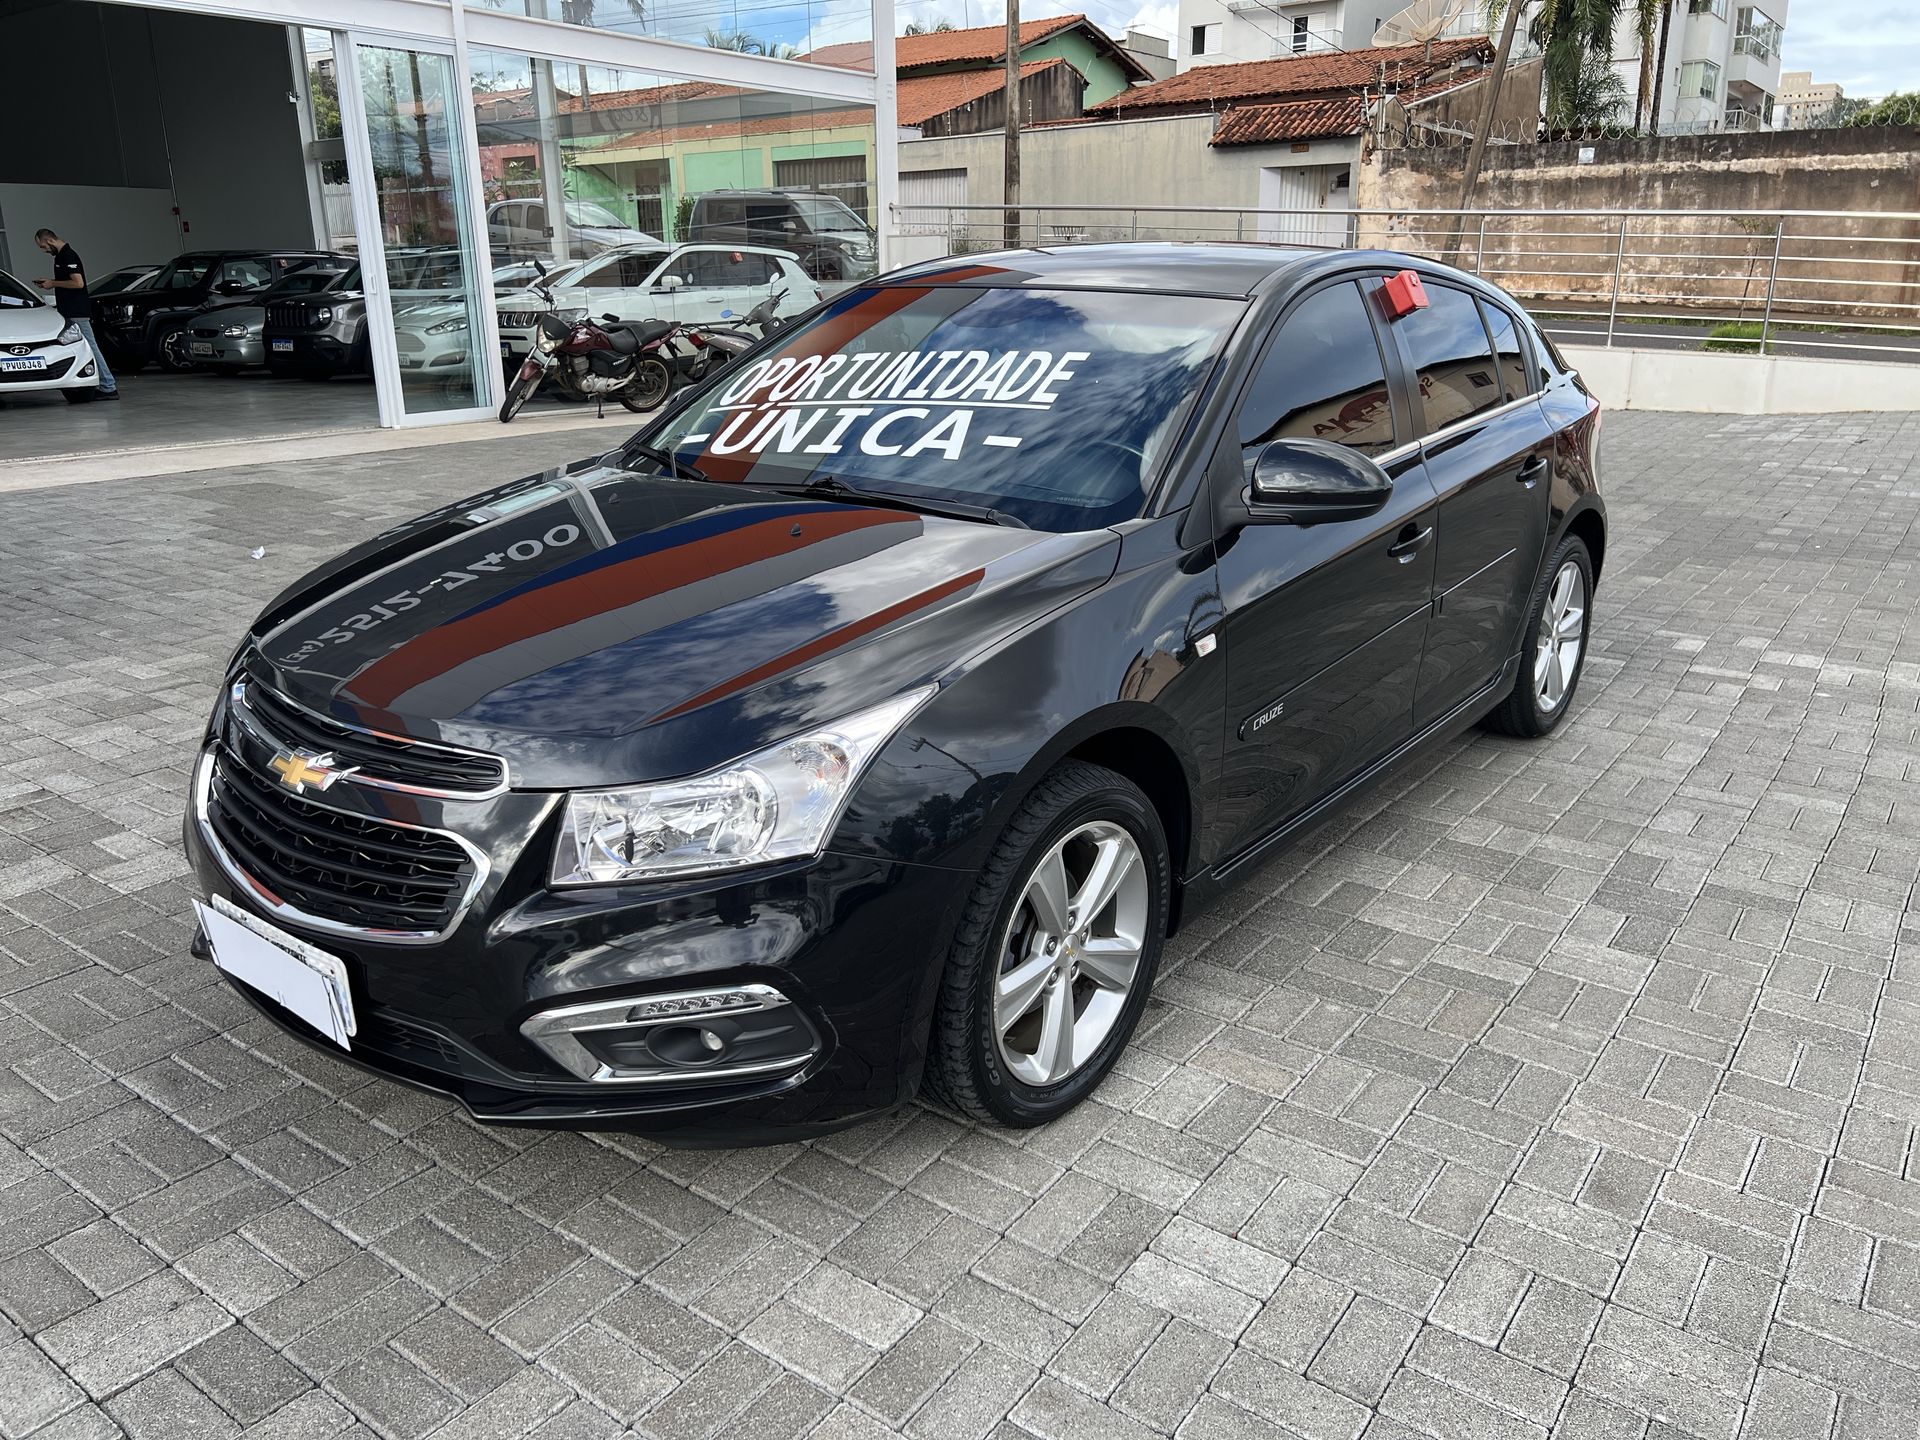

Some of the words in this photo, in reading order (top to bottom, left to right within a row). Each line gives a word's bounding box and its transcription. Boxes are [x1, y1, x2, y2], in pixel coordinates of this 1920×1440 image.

[6, 361, 42, 370] PWU8J48
[719, 350, 1091, 403] OPORTUNIDADE
[709, 402, 974, 460] ÚNICA
[1252, 702, 1284, 731] CRUZE
